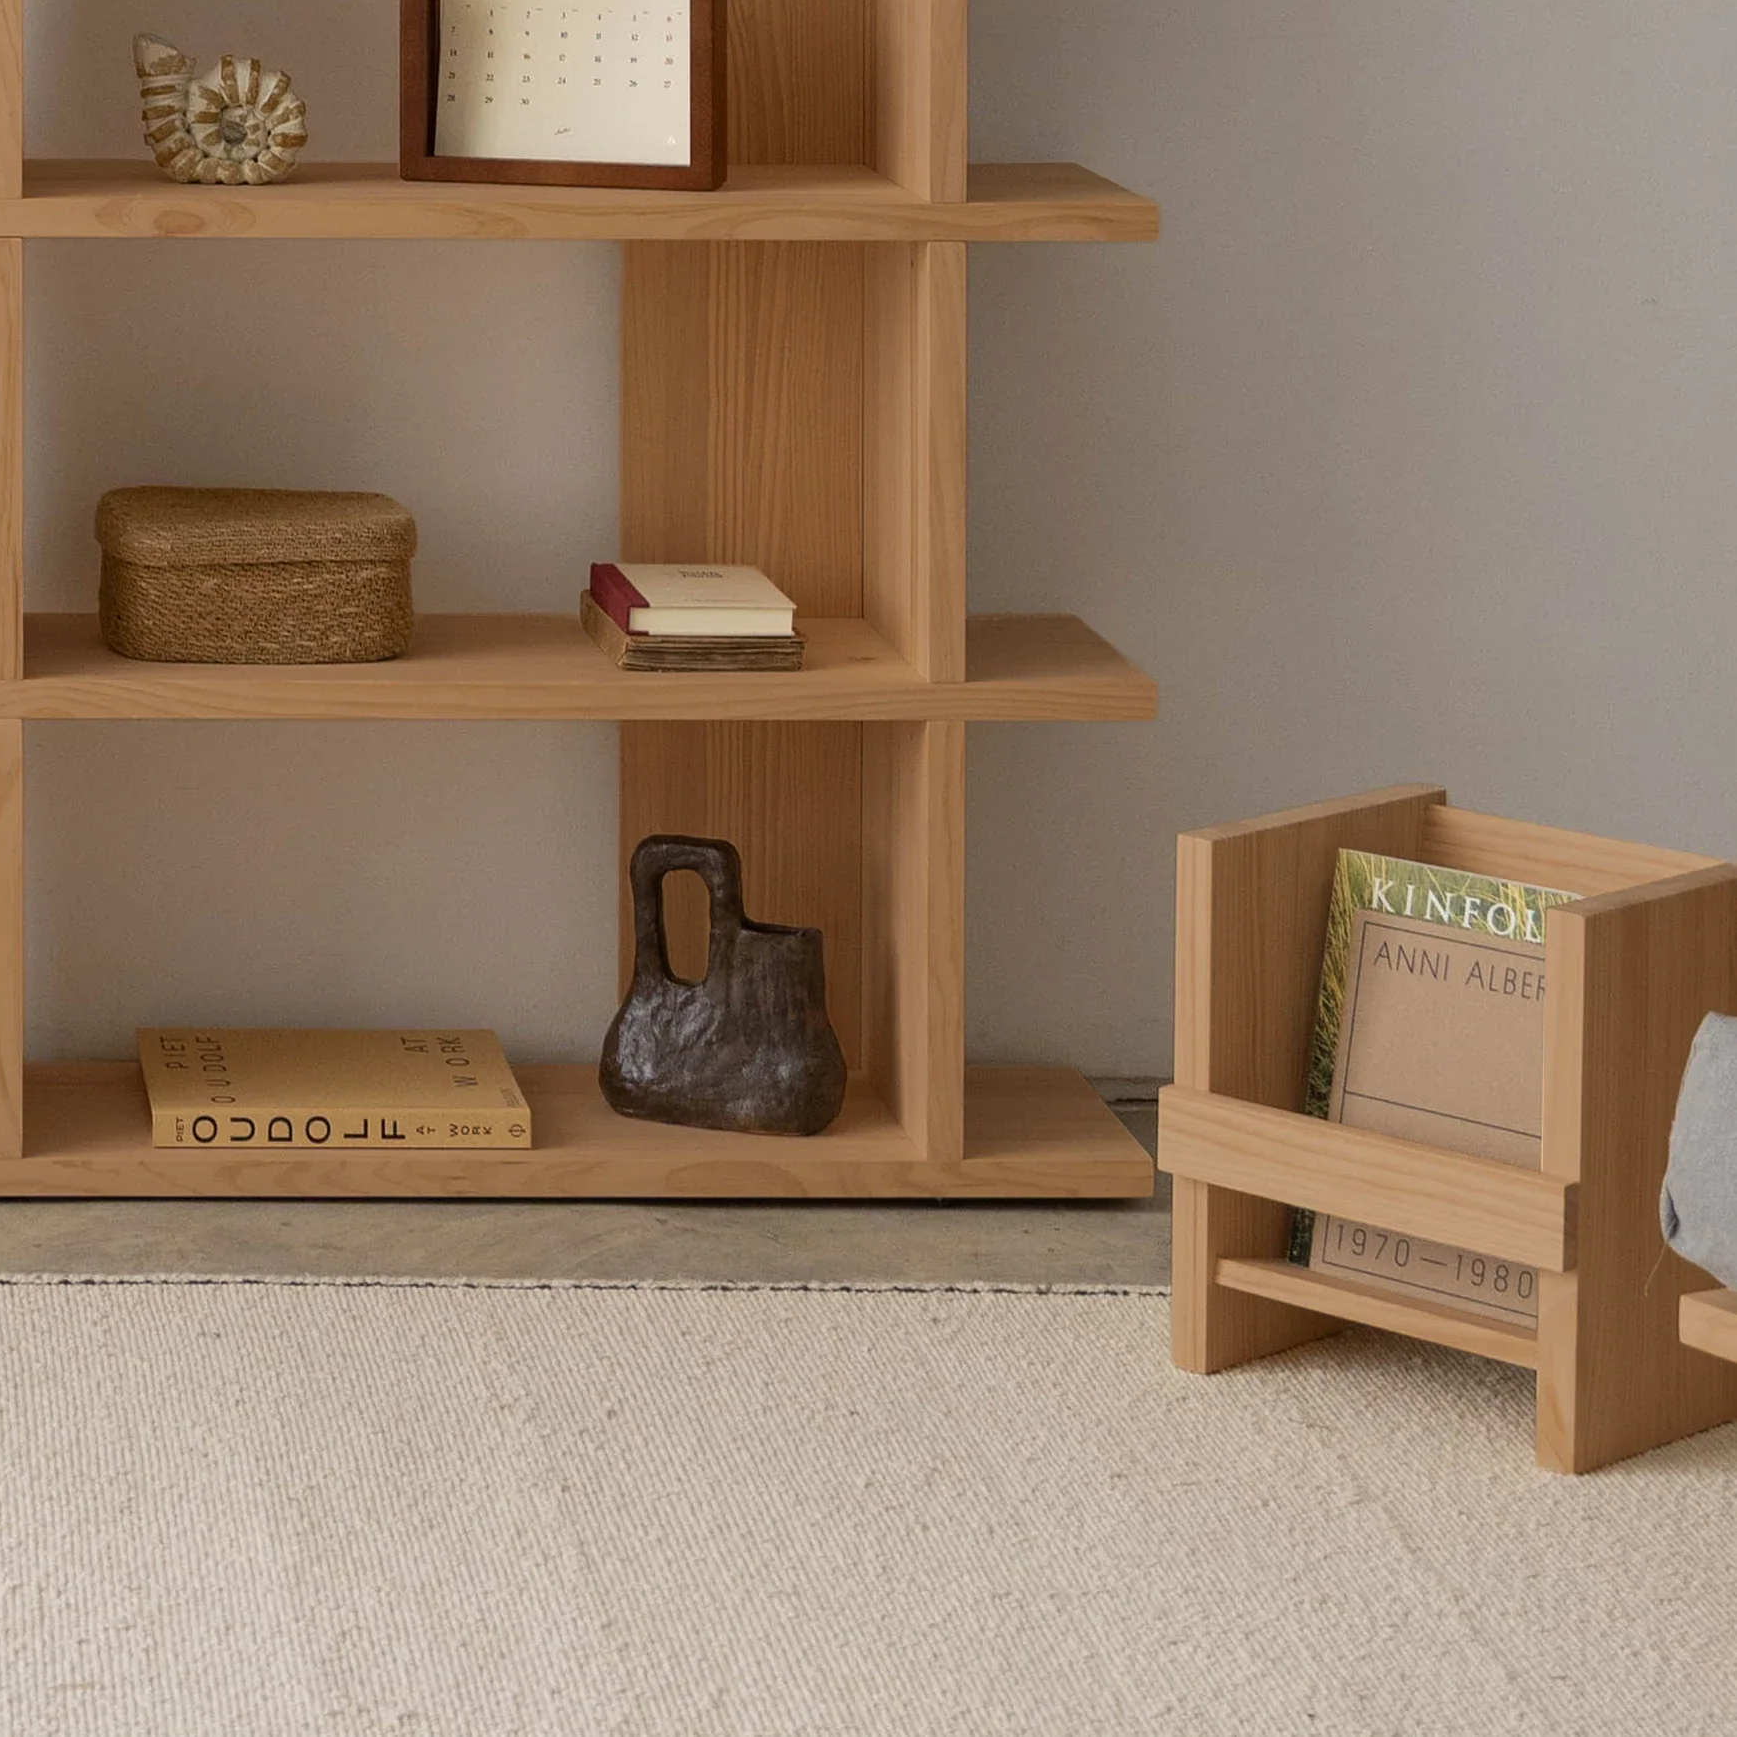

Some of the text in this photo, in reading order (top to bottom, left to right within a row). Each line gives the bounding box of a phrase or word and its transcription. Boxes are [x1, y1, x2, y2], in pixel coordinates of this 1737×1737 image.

[1371, 877, 1543, 944] KINFOL
[1374, 940, 1545, 1002] ANNI ALBER
[160, 1036, 190, 1070] PIET
[195, 1036, 236, 1104] OUDOLF
[400, 1036, 429, 1053] AT
[437, 1036, 479, 1087] WORK
[175, 1115, 493, 1144] PIET OUDOLF AT WORK
